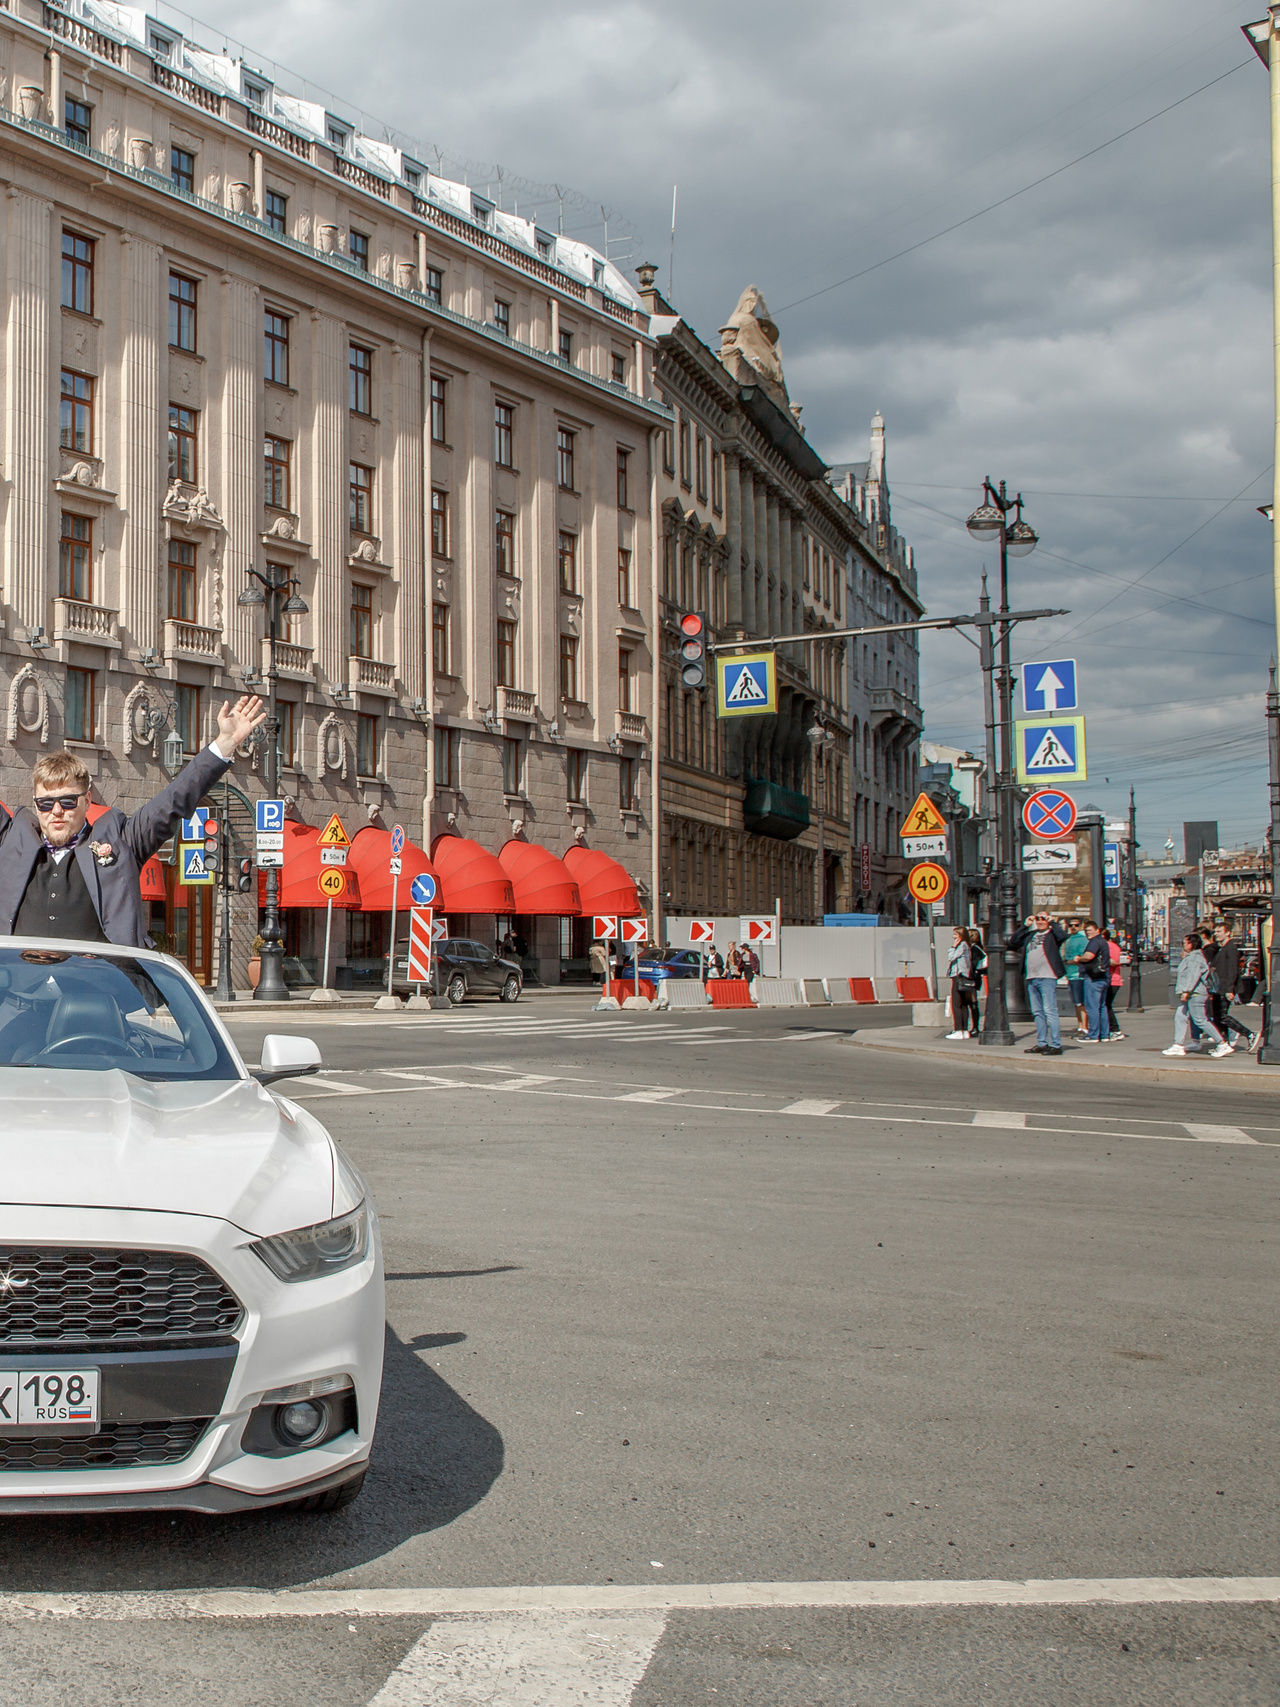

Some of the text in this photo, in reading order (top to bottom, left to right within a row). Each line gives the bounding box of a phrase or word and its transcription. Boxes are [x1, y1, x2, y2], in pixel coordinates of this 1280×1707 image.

[324, 876, 340, 889] 40
[916, 875, 939, 891] 40
[23, 1374, 85, 1407] 198
[36, 1407, 67, 1419] RUS
